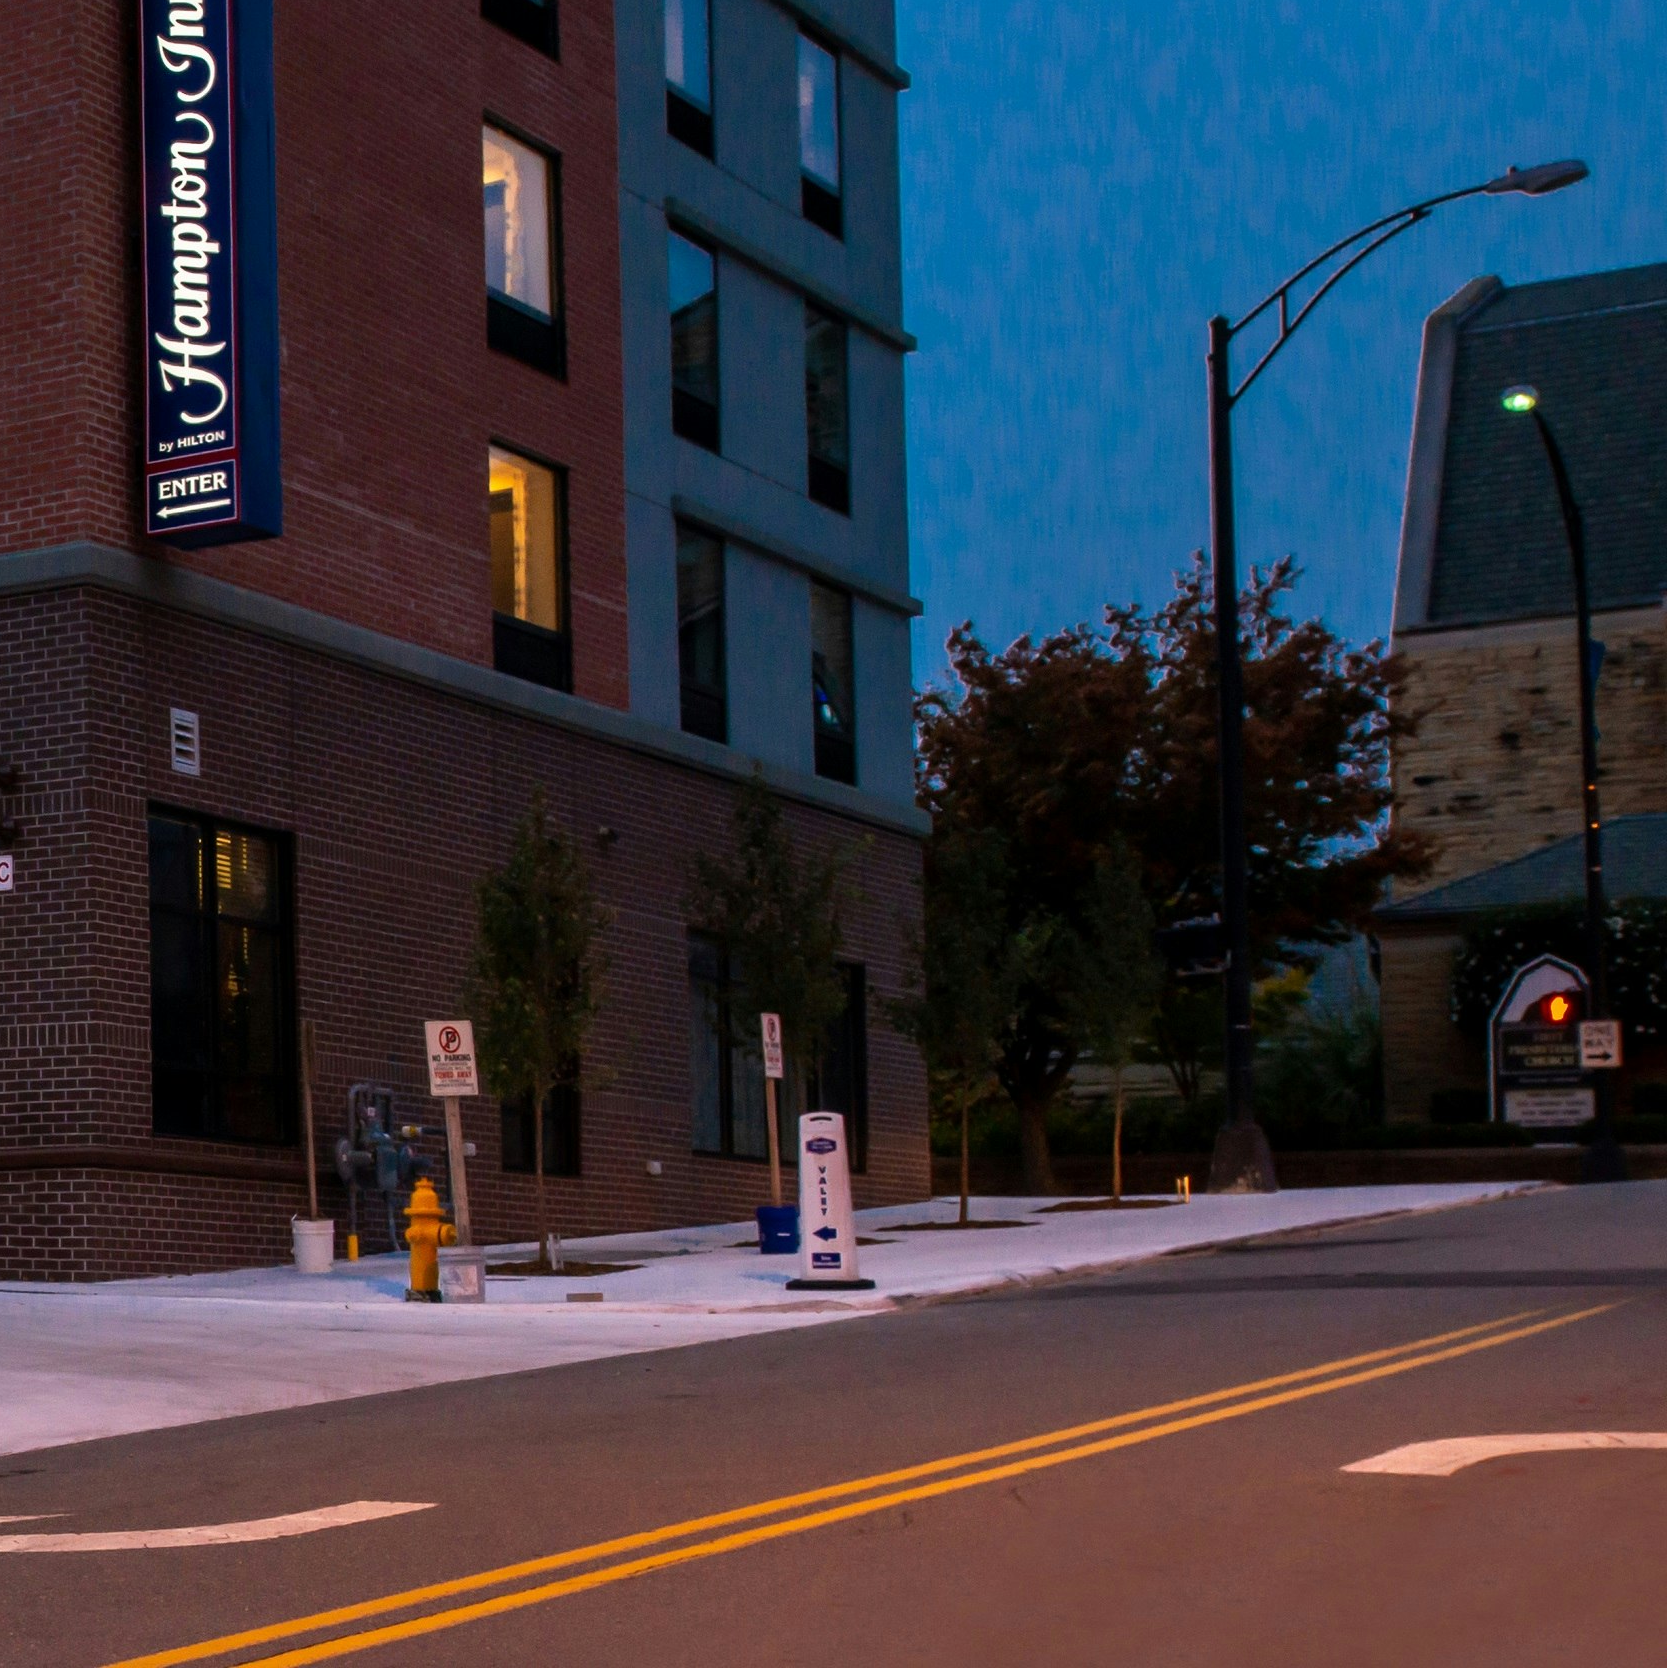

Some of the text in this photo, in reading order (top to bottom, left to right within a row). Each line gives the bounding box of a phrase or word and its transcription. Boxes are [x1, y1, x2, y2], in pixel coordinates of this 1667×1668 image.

[154, 112, 229, 424] Hampton
[159, 430, 226, 452] by HILTON
[158, 472, 227, 500] ENTER
[432, 1054, 472, 1062] NO PARKING
[434, 1071, 454, 1079] TOWED
[818, 1166, 827, 1216] VALET
